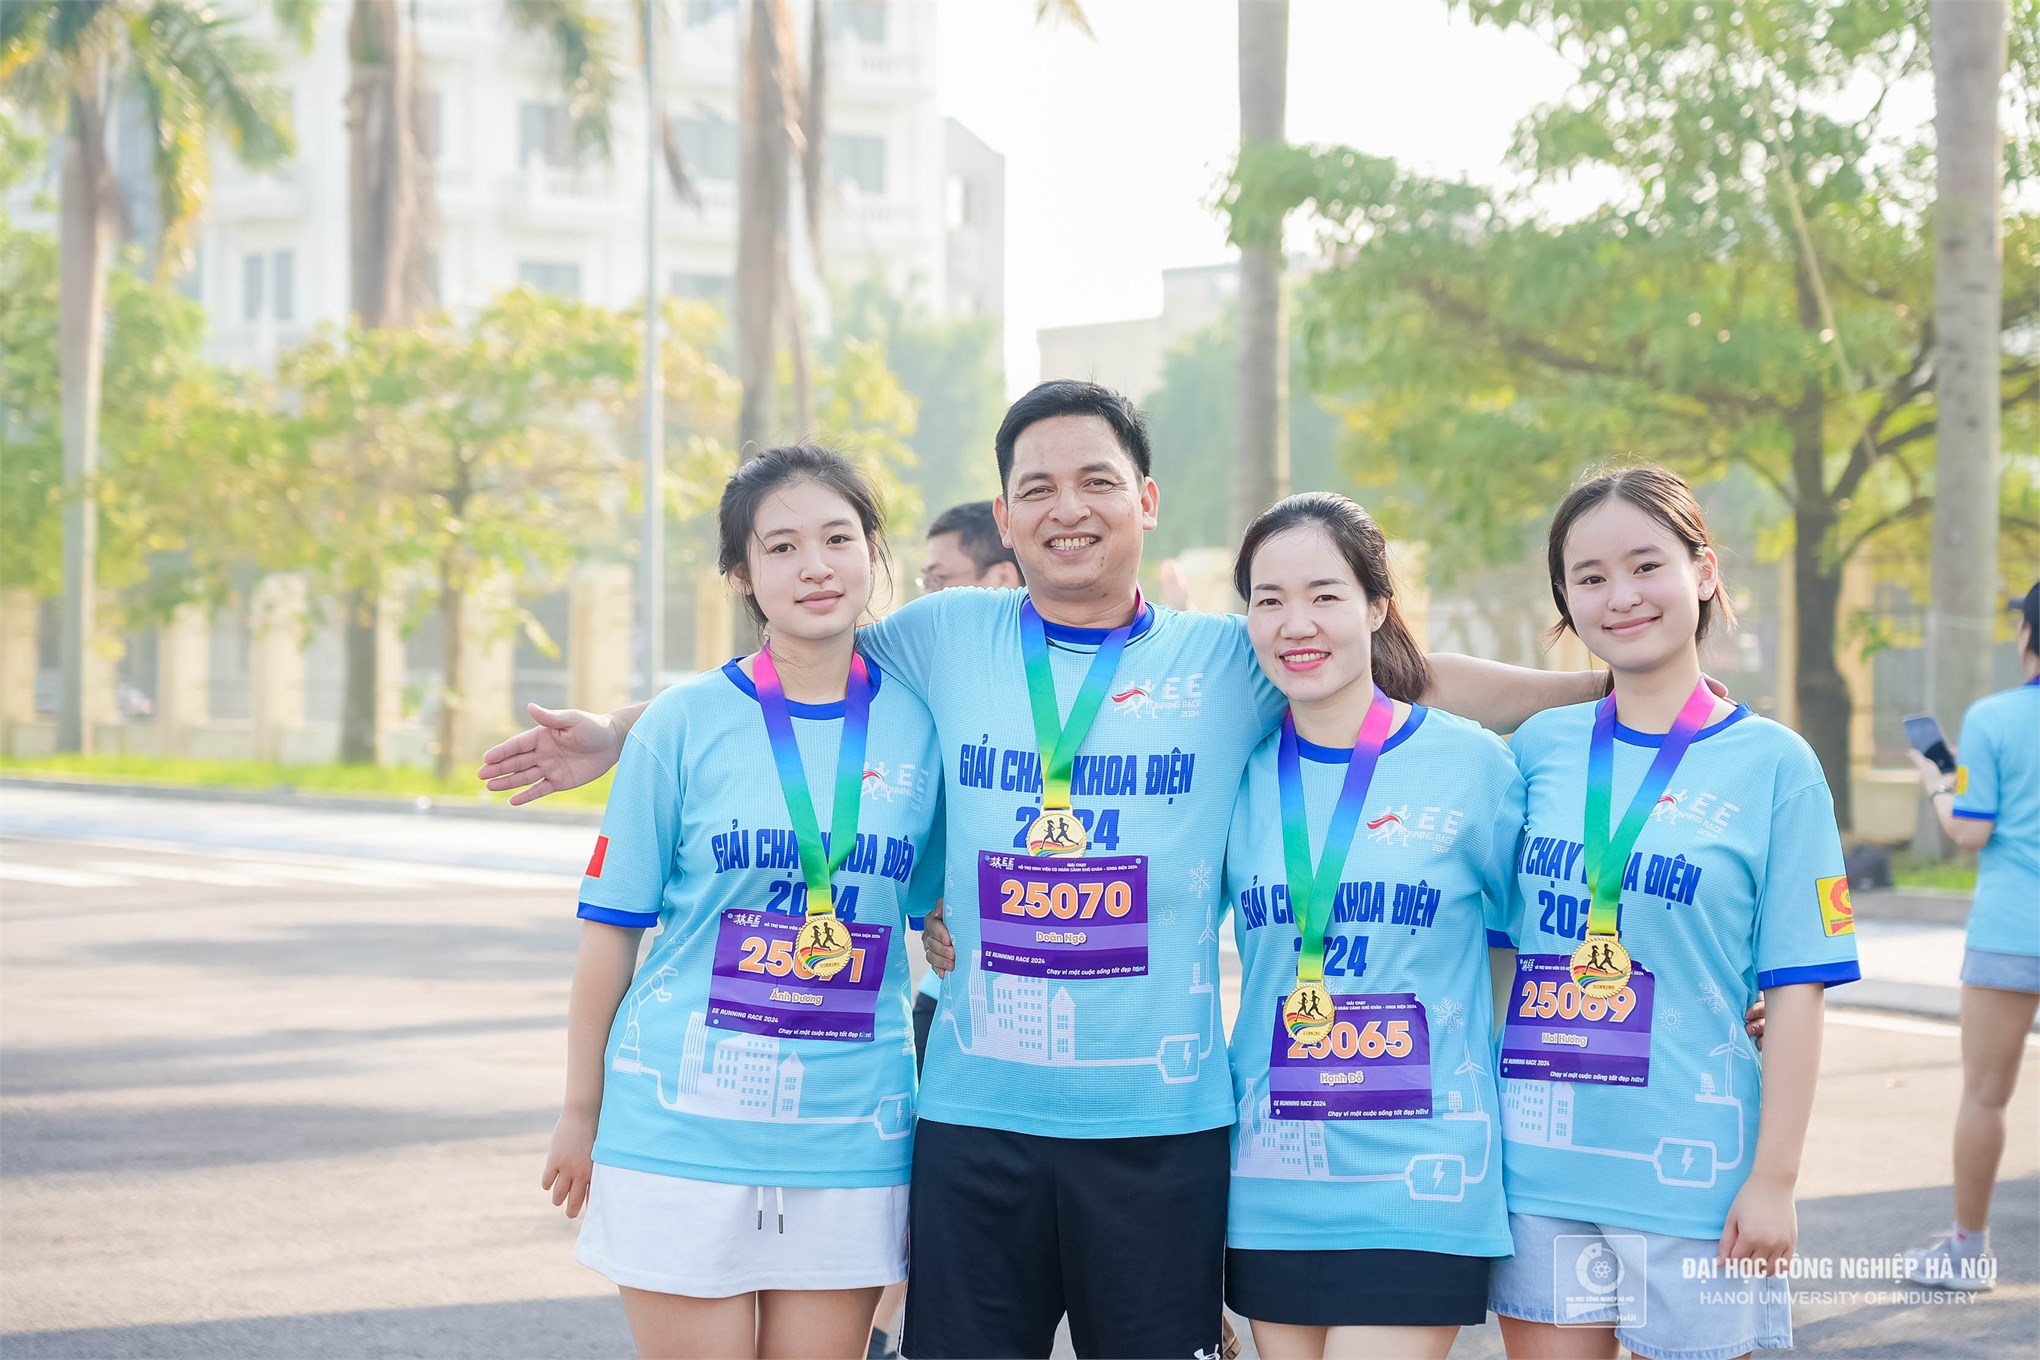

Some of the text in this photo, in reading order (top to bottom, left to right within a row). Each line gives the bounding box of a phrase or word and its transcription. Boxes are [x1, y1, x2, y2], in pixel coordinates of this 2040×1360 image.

[959, 733, 1196, 805] GIẢI CHẠ KHOA ĐIỆN
[711, 818, 749, 874] GIẢI
[755, 828, 800, 878] CHẠ
[1012, 806, 1120, 851] 224
[1525, 836, 1585, 889] CHẠY
[1644, 853, 1703, 910] ĐIỆN
[766, 880, 860, 924] 204
[1001, 879, 1132, 920] 25070
[1240, 874, 1268, 931] GIẢI
[1334, 881, 1385, 924] KHOA
[1391, 879, 1442, 936] ĐIỆN
[738, 936, 866, 983] 251
[992, 952, 1015, 961] RUNNING
[1015, 955, 1030, 963] RACE
[1064, 931, 1087, 946] Ngô
[719, 1008, 747, 1019] RUNNING
[747, 1012, 763, 1022] RACE
[763, 1015, 779, 1024] 2024
[792, 993, 824, 1007] Dương
[1519, 980, 1637, 1023] 25069
[1541, 1032, 1558, 1044] Mai
[1320, 1072, 1347, 1086] Hạnh
